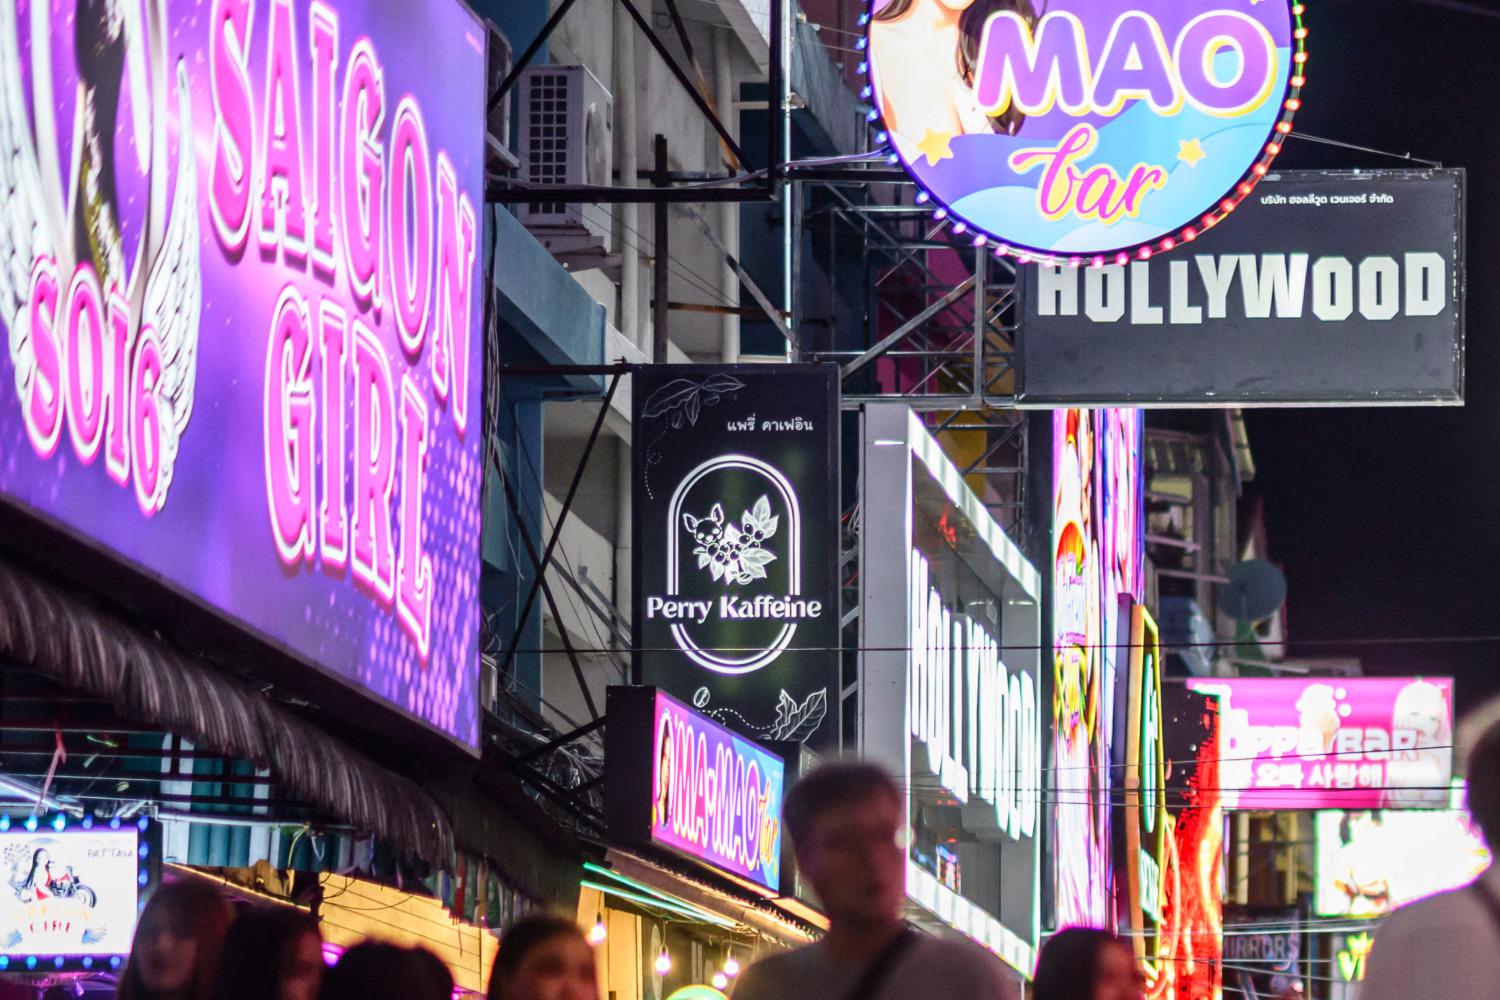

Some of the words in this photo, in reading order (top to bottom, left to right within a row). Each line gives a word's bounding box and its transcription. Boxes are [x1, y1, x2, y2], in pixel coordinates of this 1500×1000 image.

[974, 9, 1278, 117] MAO
[208, 0, 476, 438] SAIGON
[1008, 123, 1168, 224] bar
[1037, 252, 1446, 324] HOLLYWOOD
[263, 283, 433, 672] GIRL
[646, 596, 713, 624] Perry
[719, 595, 822, 620] Kaffeine
